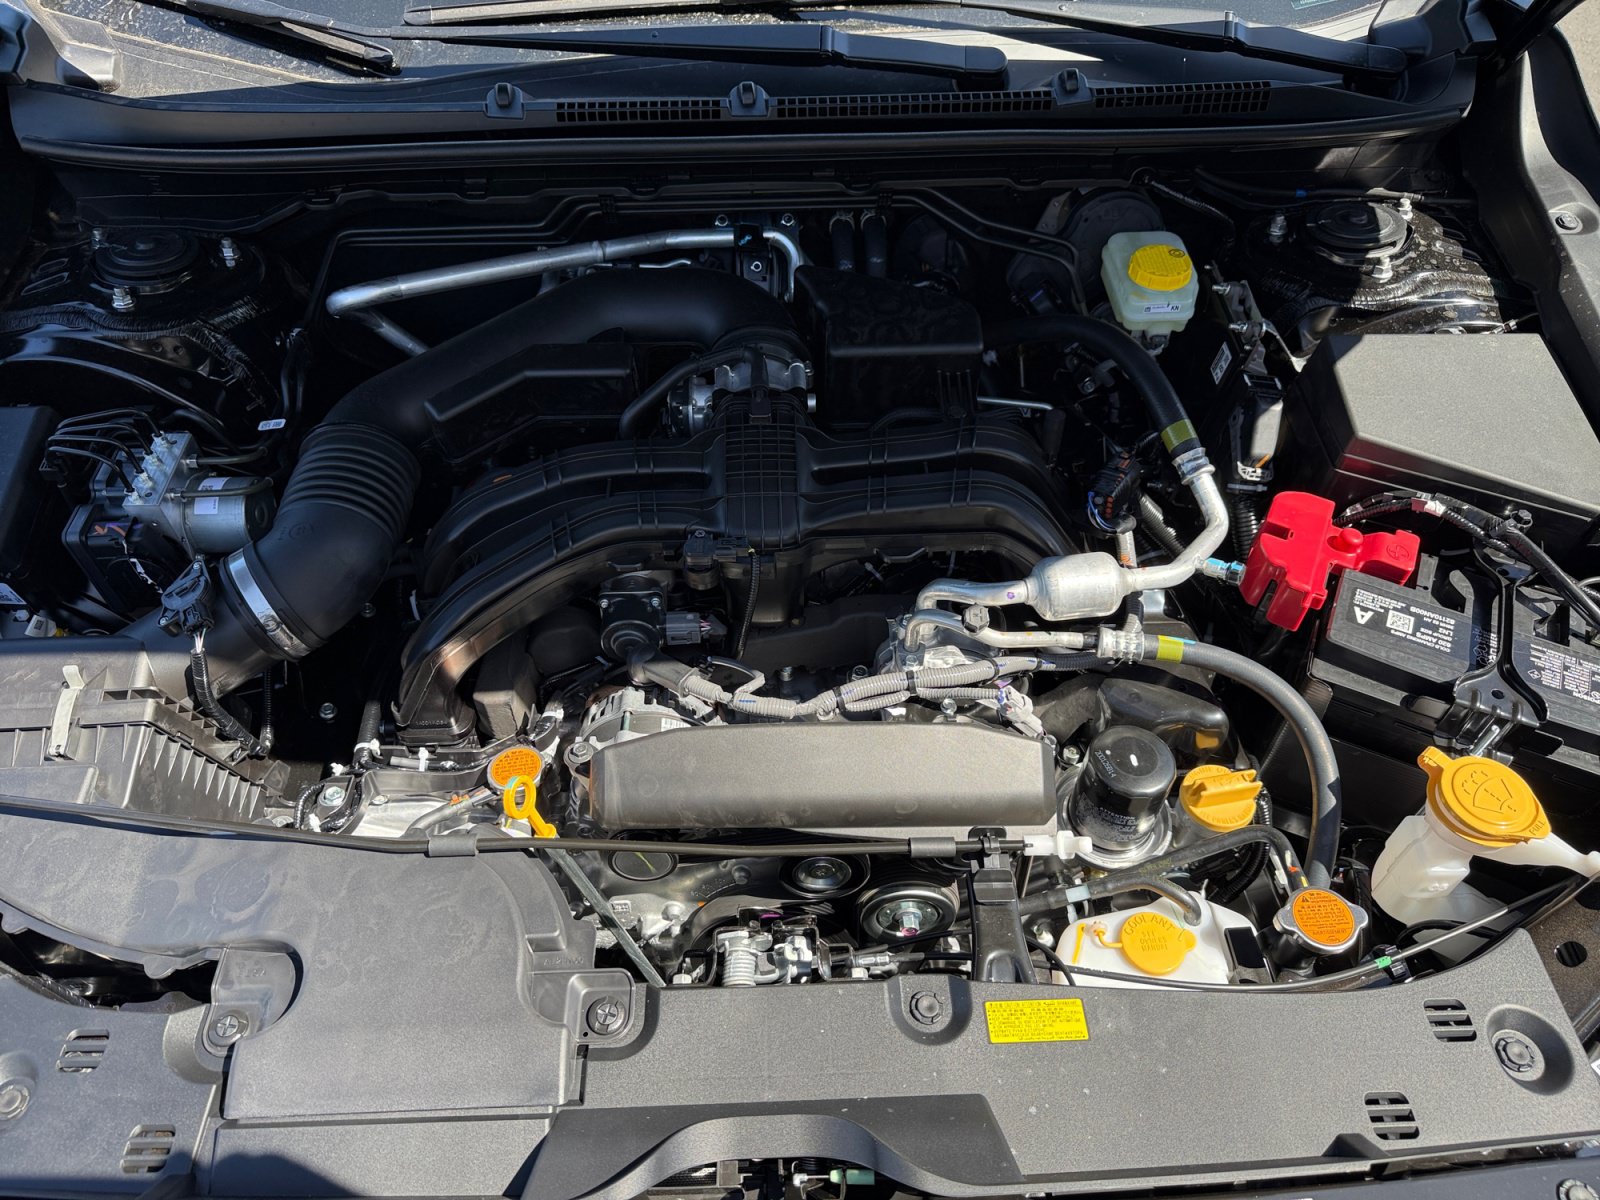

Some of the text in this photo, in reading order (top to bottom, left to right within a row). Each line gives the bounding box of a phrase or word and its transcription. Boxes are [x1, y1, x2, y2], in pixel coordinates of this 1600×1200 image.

[1354, 606, 1374, 625] A
[1390, 629, 1451, 652] COLD CRANKING AMPS
[1415, 632, 1438, 643] AMPS
[1433, 632, 1452, 641] GROUP
[1100, 807, 1136, 820] ATTENTION
[1529, 820, 1546, 836] FULL
[1124, 914, 1176, 936] COOLANT
